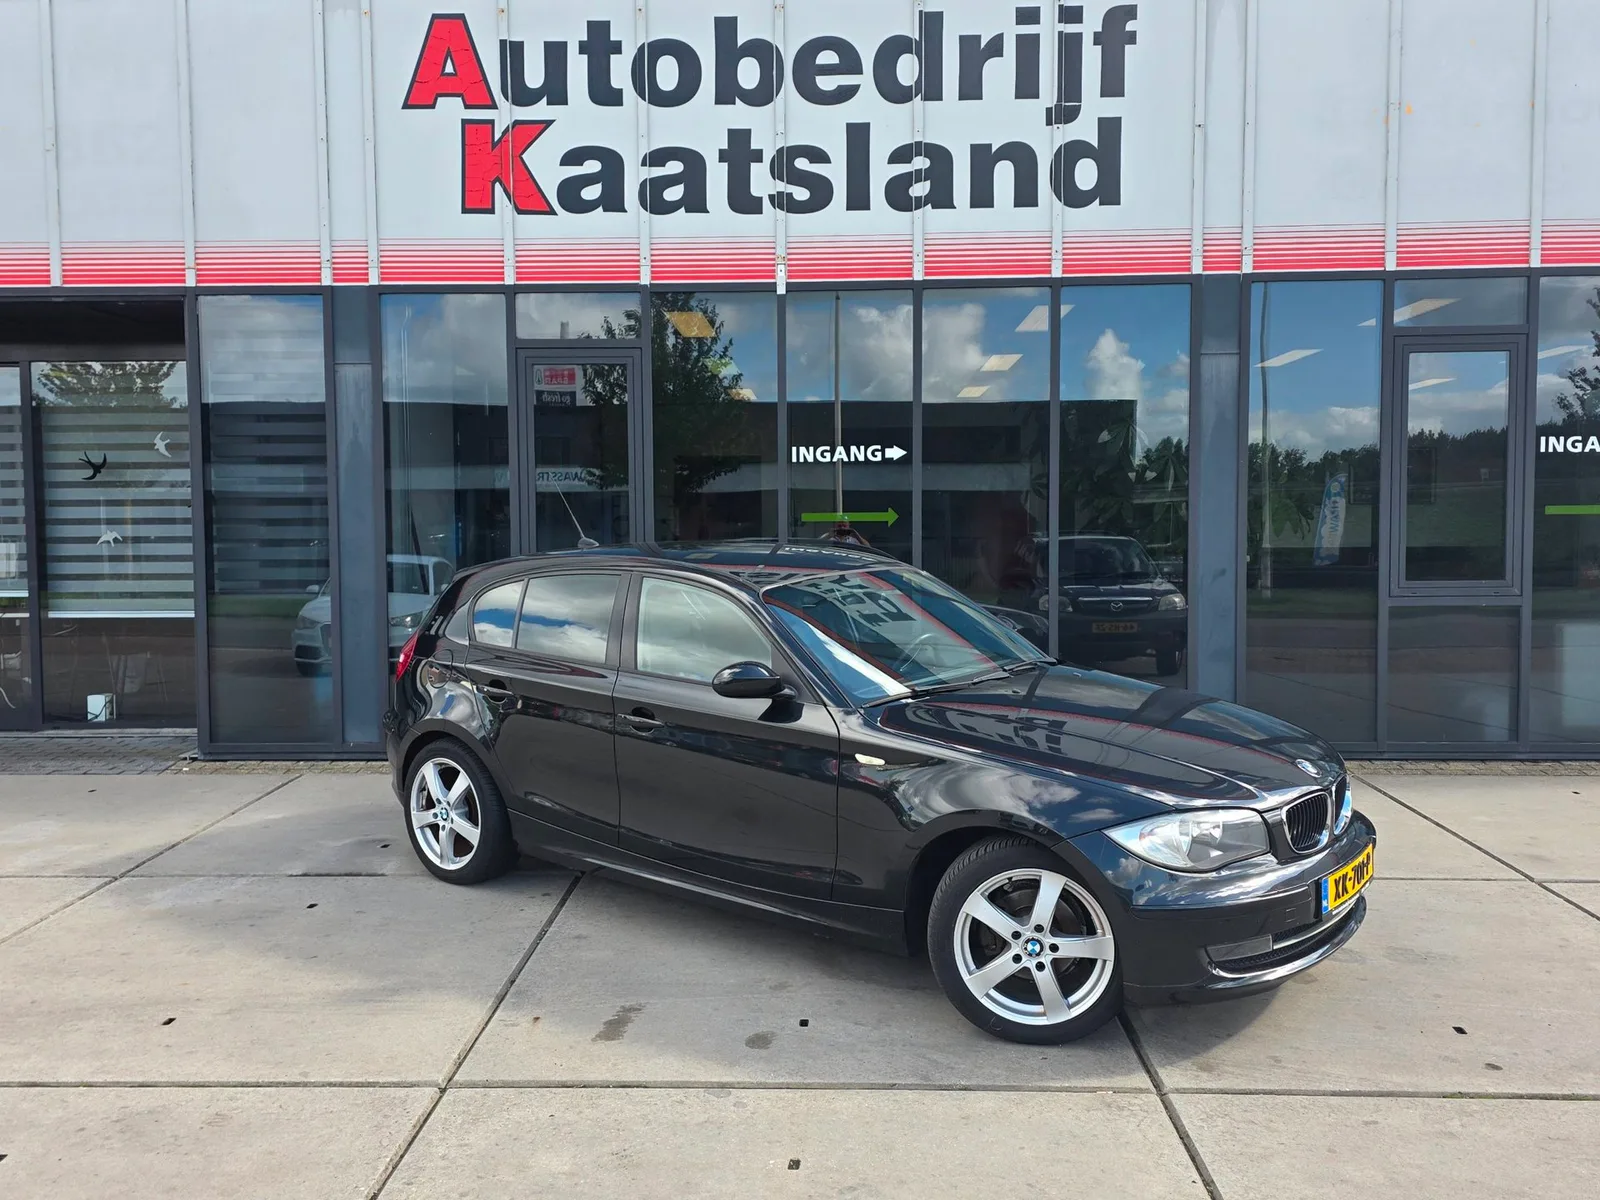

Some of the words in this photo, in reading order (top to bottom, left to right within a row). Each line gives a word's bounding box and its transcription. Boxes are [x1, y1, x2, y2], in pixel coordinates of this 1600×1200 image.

[402, 5, 1137, 126] Autobedrijf
[461, 117, 1123, 216] Kaatsland
[791, 445, 883, 463] INGANG
[1540, 435, 1600, 453] INGA
